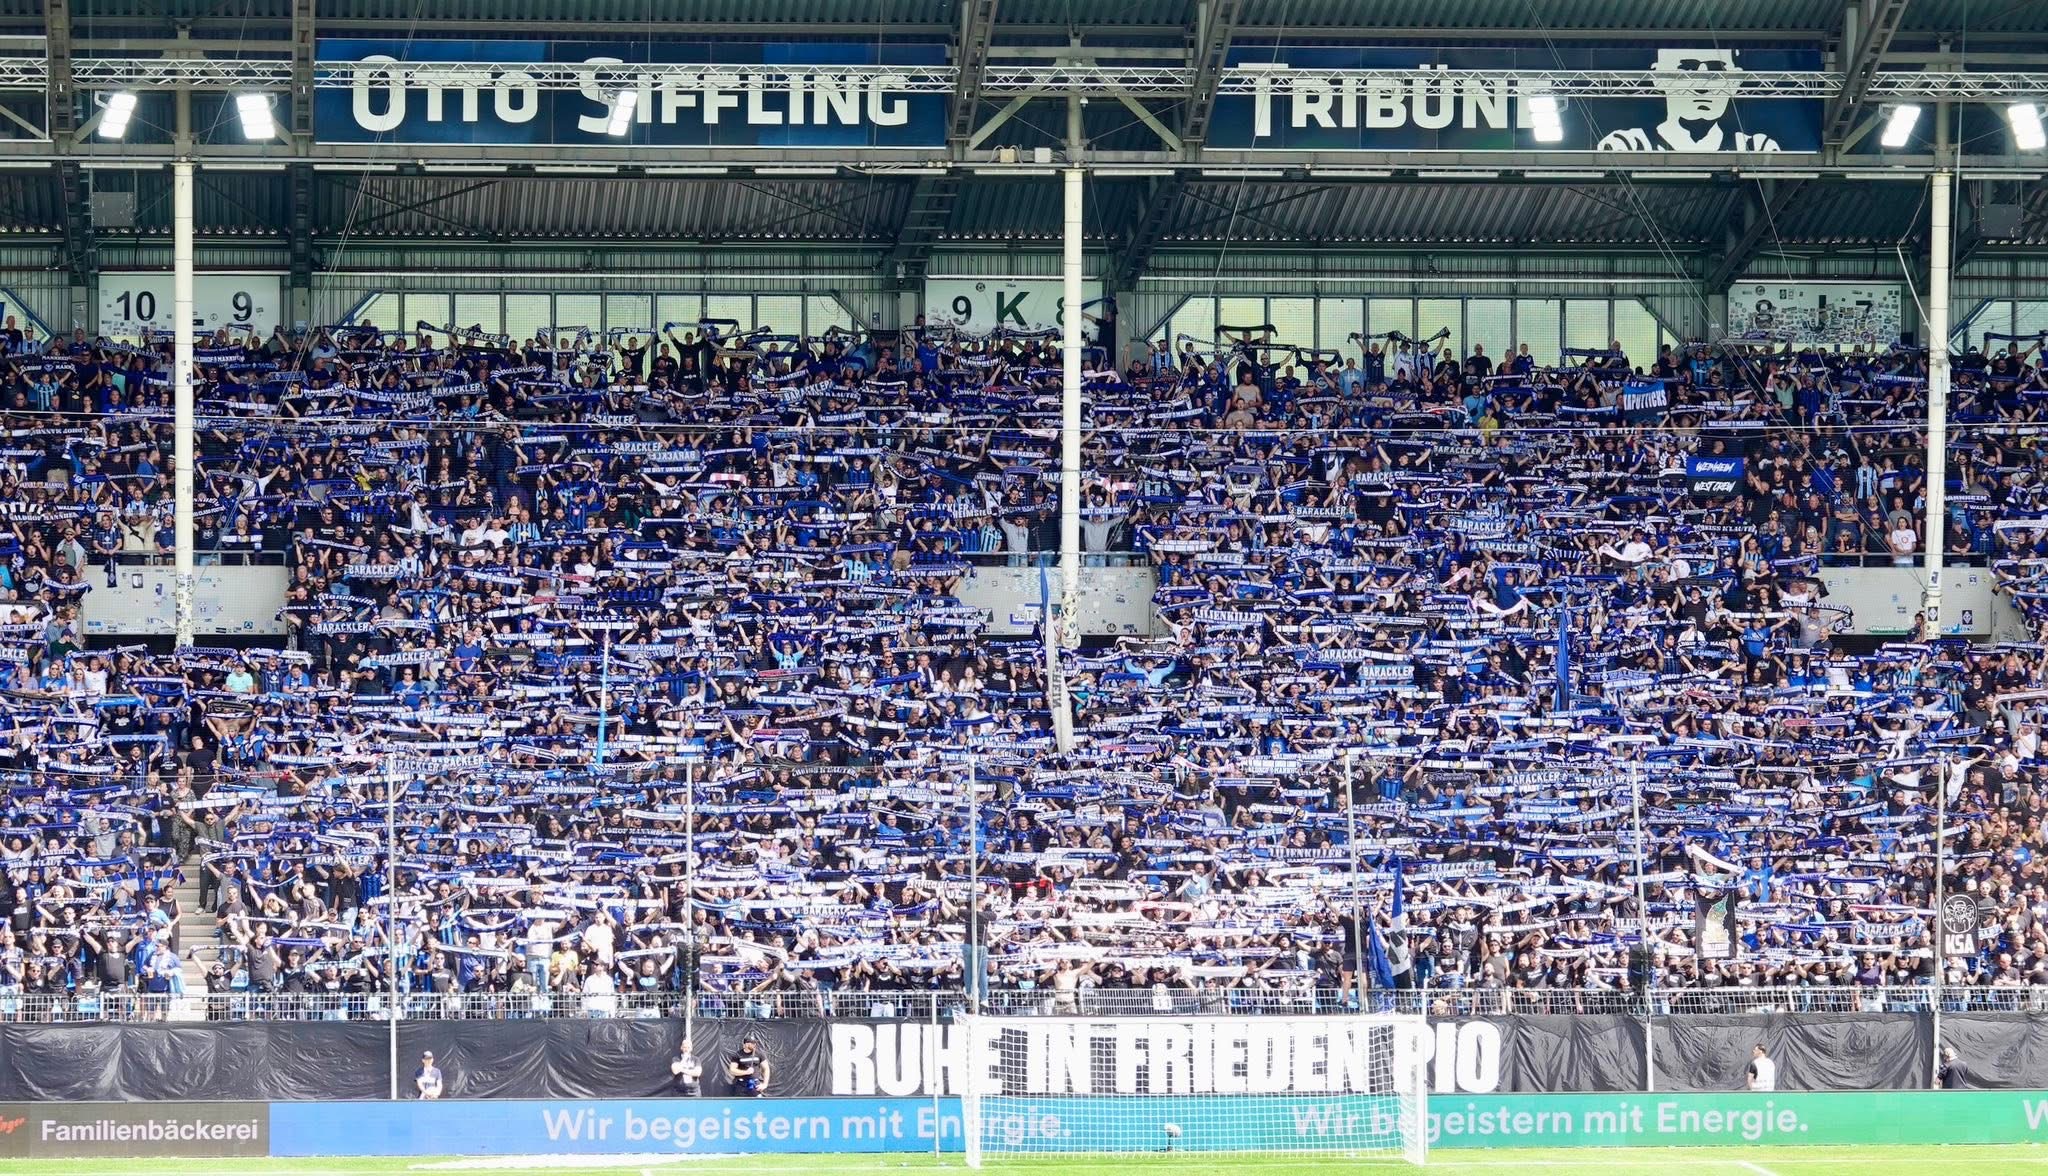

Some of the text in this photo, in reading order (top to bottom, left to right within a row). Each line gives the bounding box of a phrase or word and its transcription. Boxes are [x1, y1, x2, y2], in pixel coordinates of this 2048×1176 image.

[352, 55, 908, 133] OTTO SIFFLING
[116, 291, 253, 321] 10 9
[952, 296, 972, 326] 9
[996, 291, 1030, 330] K
[432, 383, 480, 394] BARACKLER
[614, 443, 661, 452] BARACKLER
[1433, 445, 1481, 455] BARACKLER
[1696, 462, 1735, 474] WEINHEIM
[1043, 471, 1092, 481] BARAER
[1694, 481, 1736, 492] WEST CREW
[1297, 507, 1347, 515] BARACKLER
[1457, 520, 1506, 531] BARACKLER
[1479, 542, 1528, 551] BARACKLER
[349, 565, 398, 575] BARACKLER
[1195, 609, 1264, 622] LILIENKILLER
[317, 622, 369, 632] BARACKLER
[379, 650, 430, 662] BARACKLER
[1585, 645, 1651, 658] WALDHOF MANNHEI
[1363, 666, 1414, 677] BARACKLER
[392, 760, 439, 772] ARACKLER
[1507, 772, 1559, 783] BARACKLER
[1431, 862, 1484, 872] BARACKLER
[1945, 934, 1974, 954] KSA
[831, 1021, 1501, 1096] RUHE IN FRIEDEN PIO
[543, 1107, 1072, 1148] Wir begeistern mit Enrgie.
[1292, 1101, 1809, 1143] Wir bgeistern mit Energie.
[42, 1119, 259, 1141] Familienbäckerei
